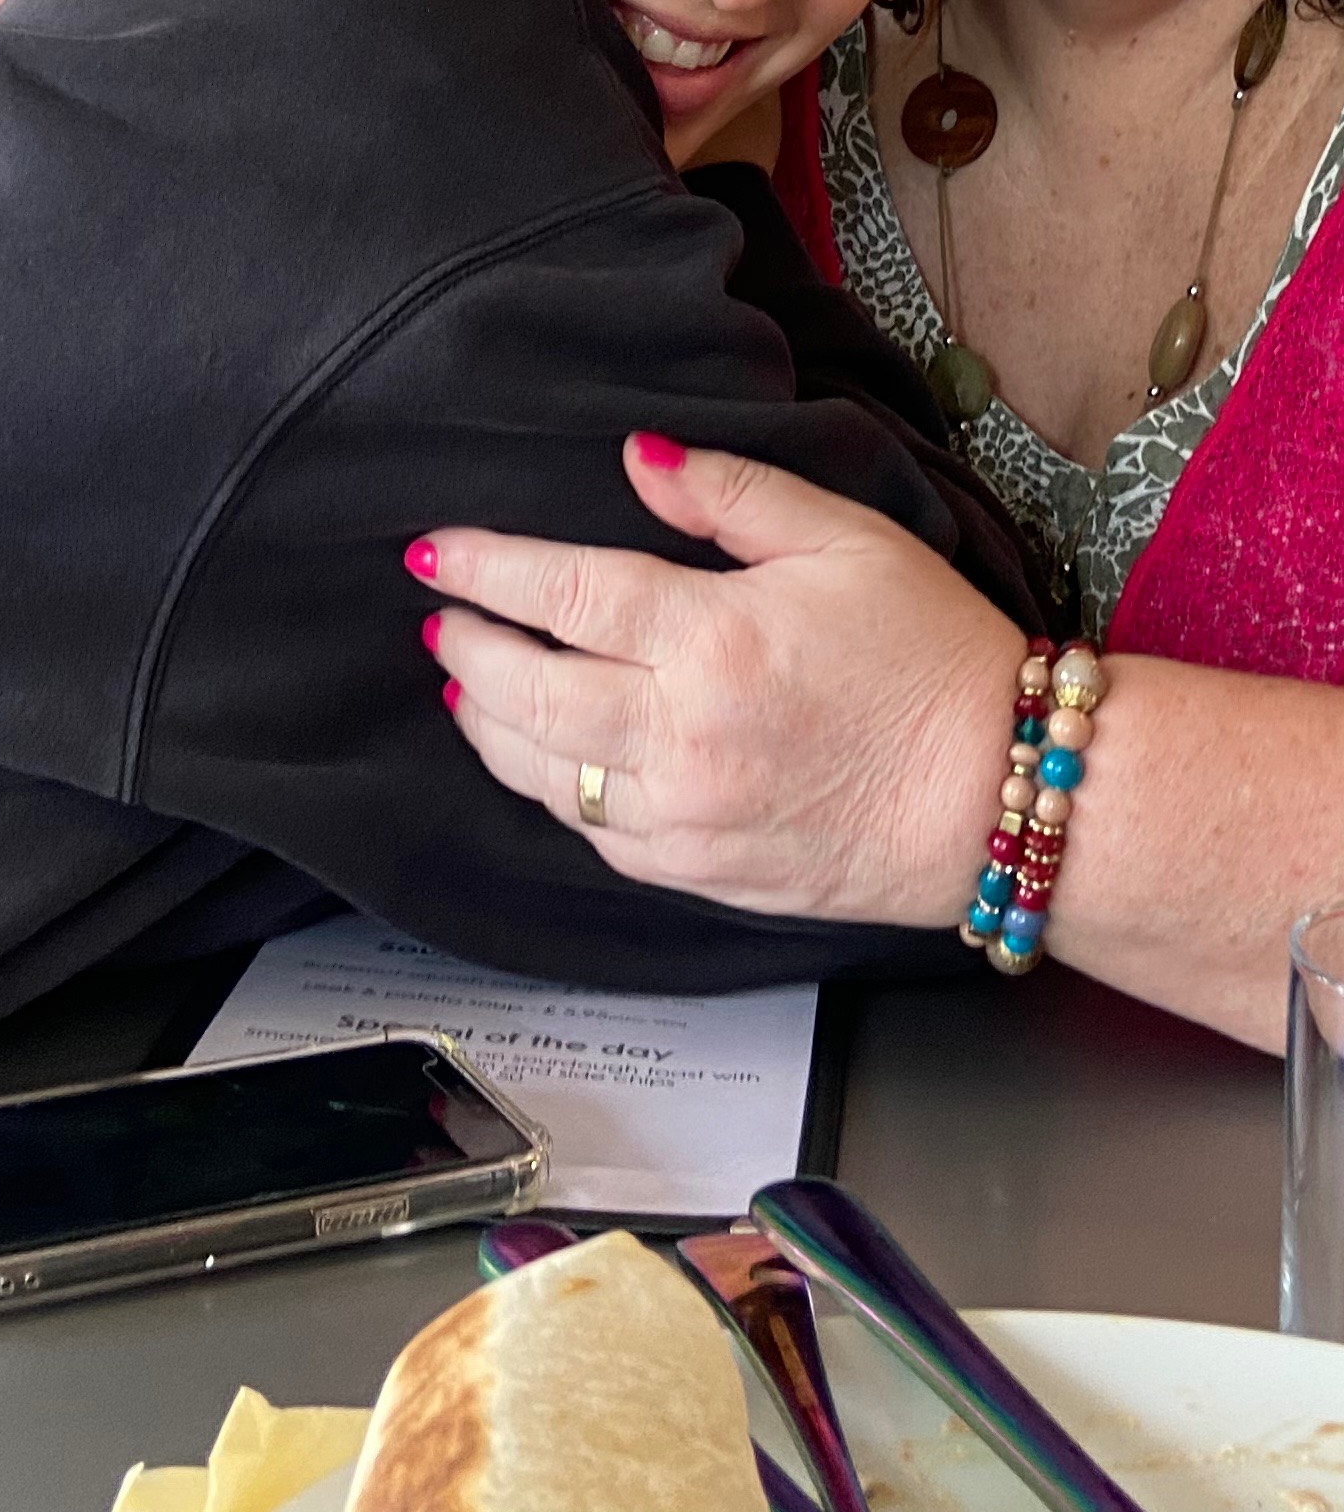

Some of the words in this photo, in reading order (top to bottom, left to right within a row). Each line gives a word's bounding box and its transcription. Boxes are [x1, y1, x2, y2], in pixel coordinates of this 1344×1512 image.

[484, 1031, 523, 1046] of
[530, 1034, 588, 1052] the
[601, 1042, 675, 1063] day
[711, 1071, 761, 1085] with
